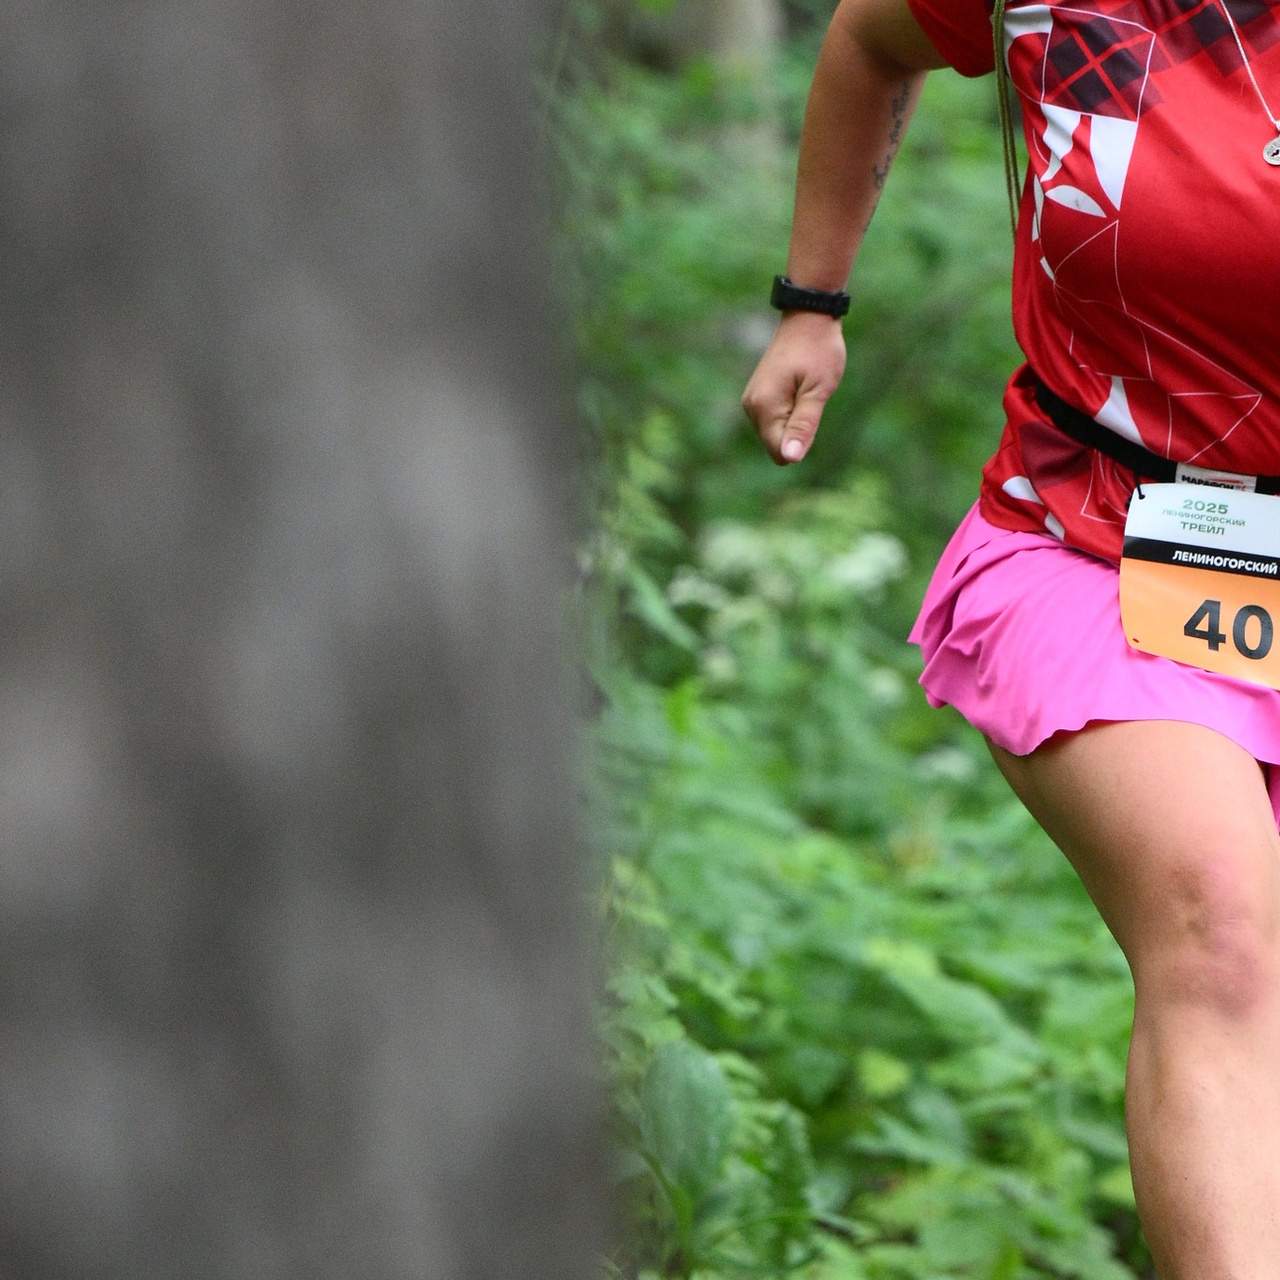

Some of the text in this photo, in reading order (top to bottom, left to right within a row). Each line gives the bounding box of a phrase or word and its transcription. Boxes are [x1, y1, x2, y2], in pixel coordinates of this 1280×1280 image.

[1183, 499, 1229, 515] 2025
[1162, 509, 1245, 527] ЛЕНИНОГОРСКИЙ
[1180, 521, 1225, 535] ТРЕЙЛ
[1172, 550, 1277, 575] ЛЕНИНОГОРСКИЙ
